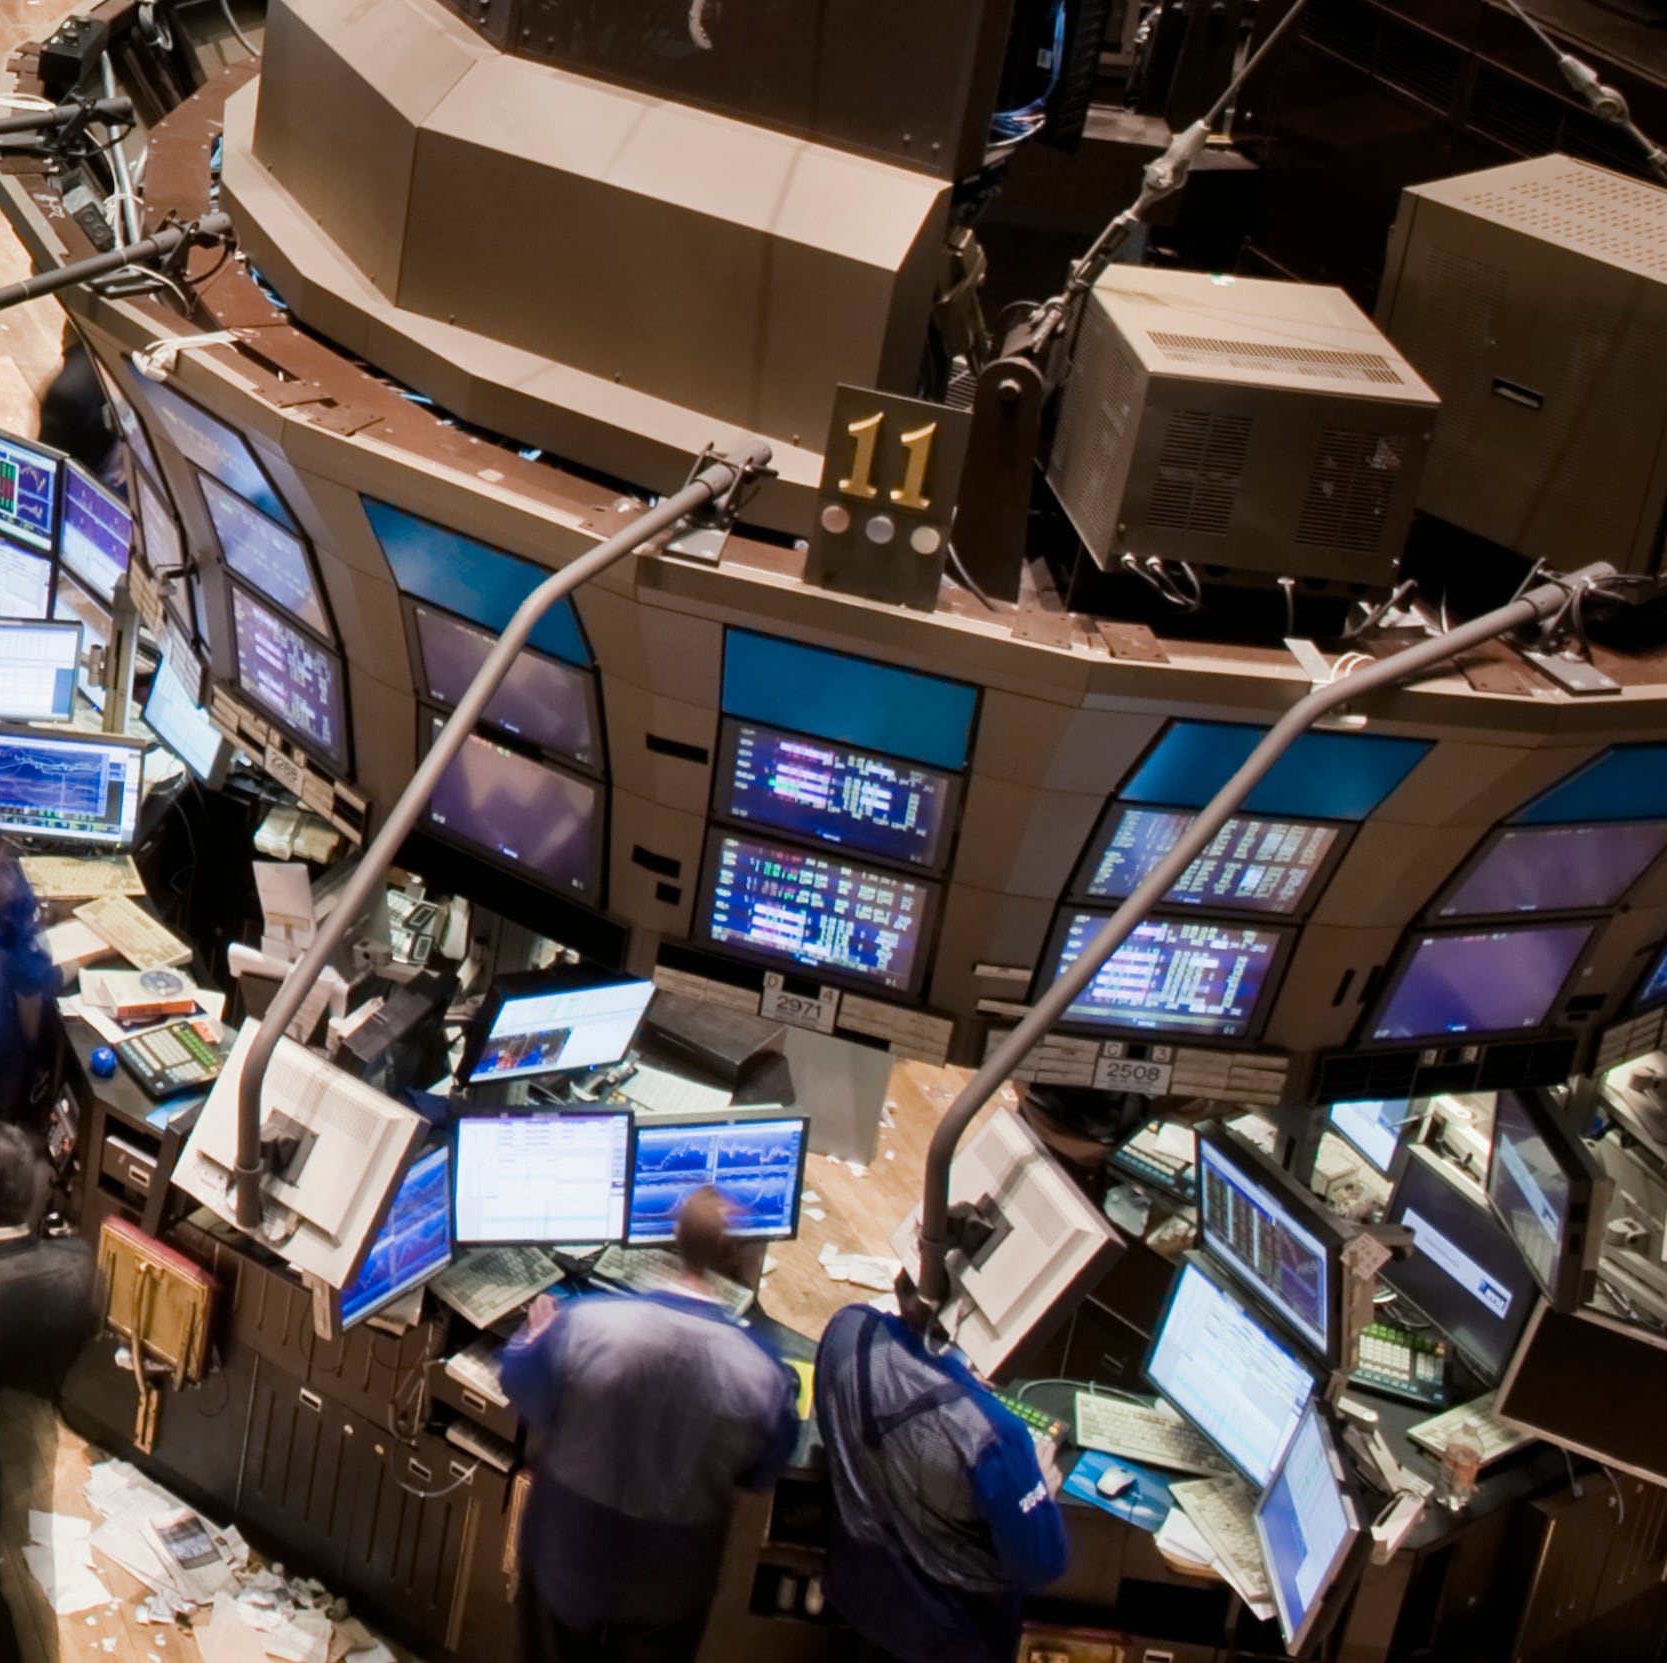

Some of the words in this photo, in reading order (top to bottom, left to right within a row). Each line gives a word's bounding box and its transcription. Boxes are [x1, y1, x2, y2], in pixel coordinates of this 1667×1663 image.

[837, 411, 936, 510] 11
[766, 975, 778, 986] D
[822, 990, 834, 1003] 4
[776, 994, 822, 1019] 2971
[1158, 1048, 1168, 1061] 3
[1107, 1062, 1161, 1082] 2508
